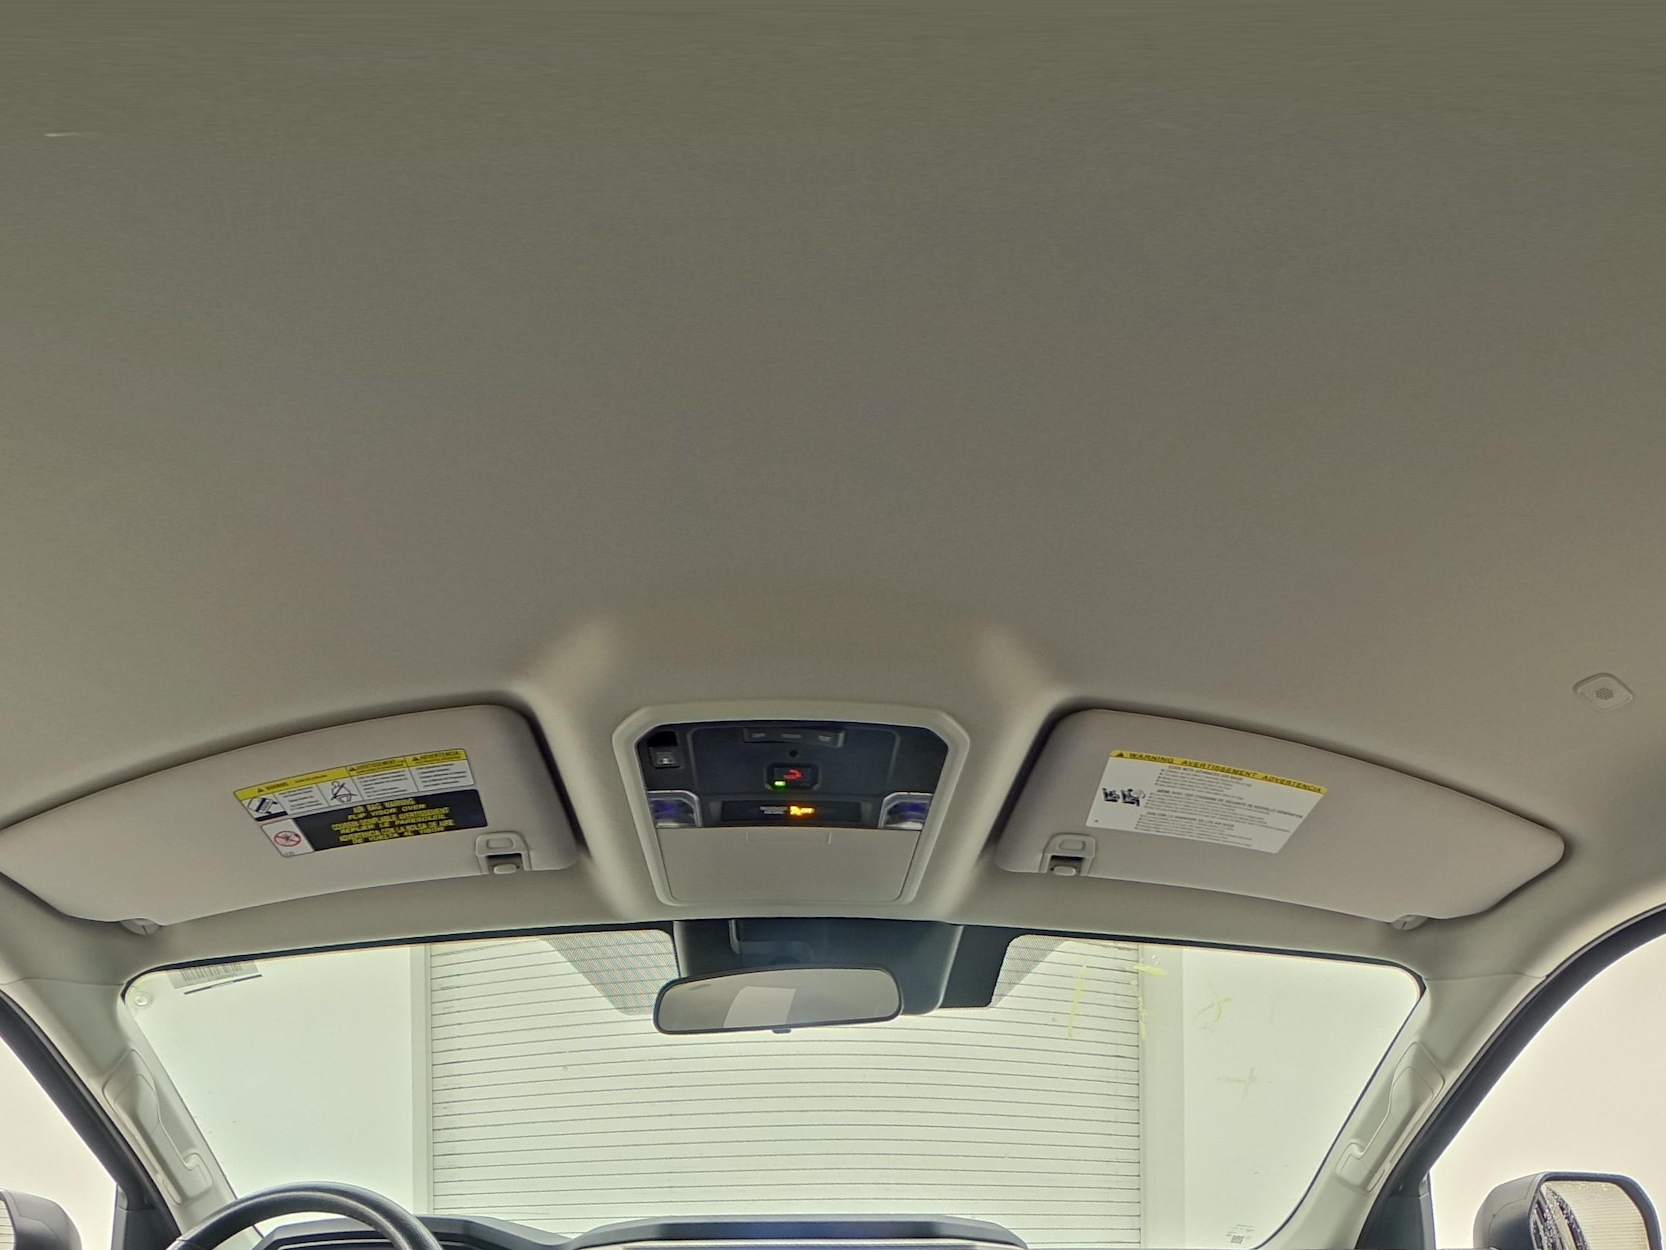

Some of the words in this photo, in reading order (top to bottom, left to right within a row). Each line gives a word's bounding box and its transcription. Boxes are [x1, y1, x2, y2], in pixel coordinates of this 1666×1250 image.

[1129, 752, 1174, 764] WARNING
[1181, 761, 1256, 778] AVERTISSEMENT
[1262, 775, 1322, 793] ADVERTENCIA
[401, 803, 426, 812] OVER
